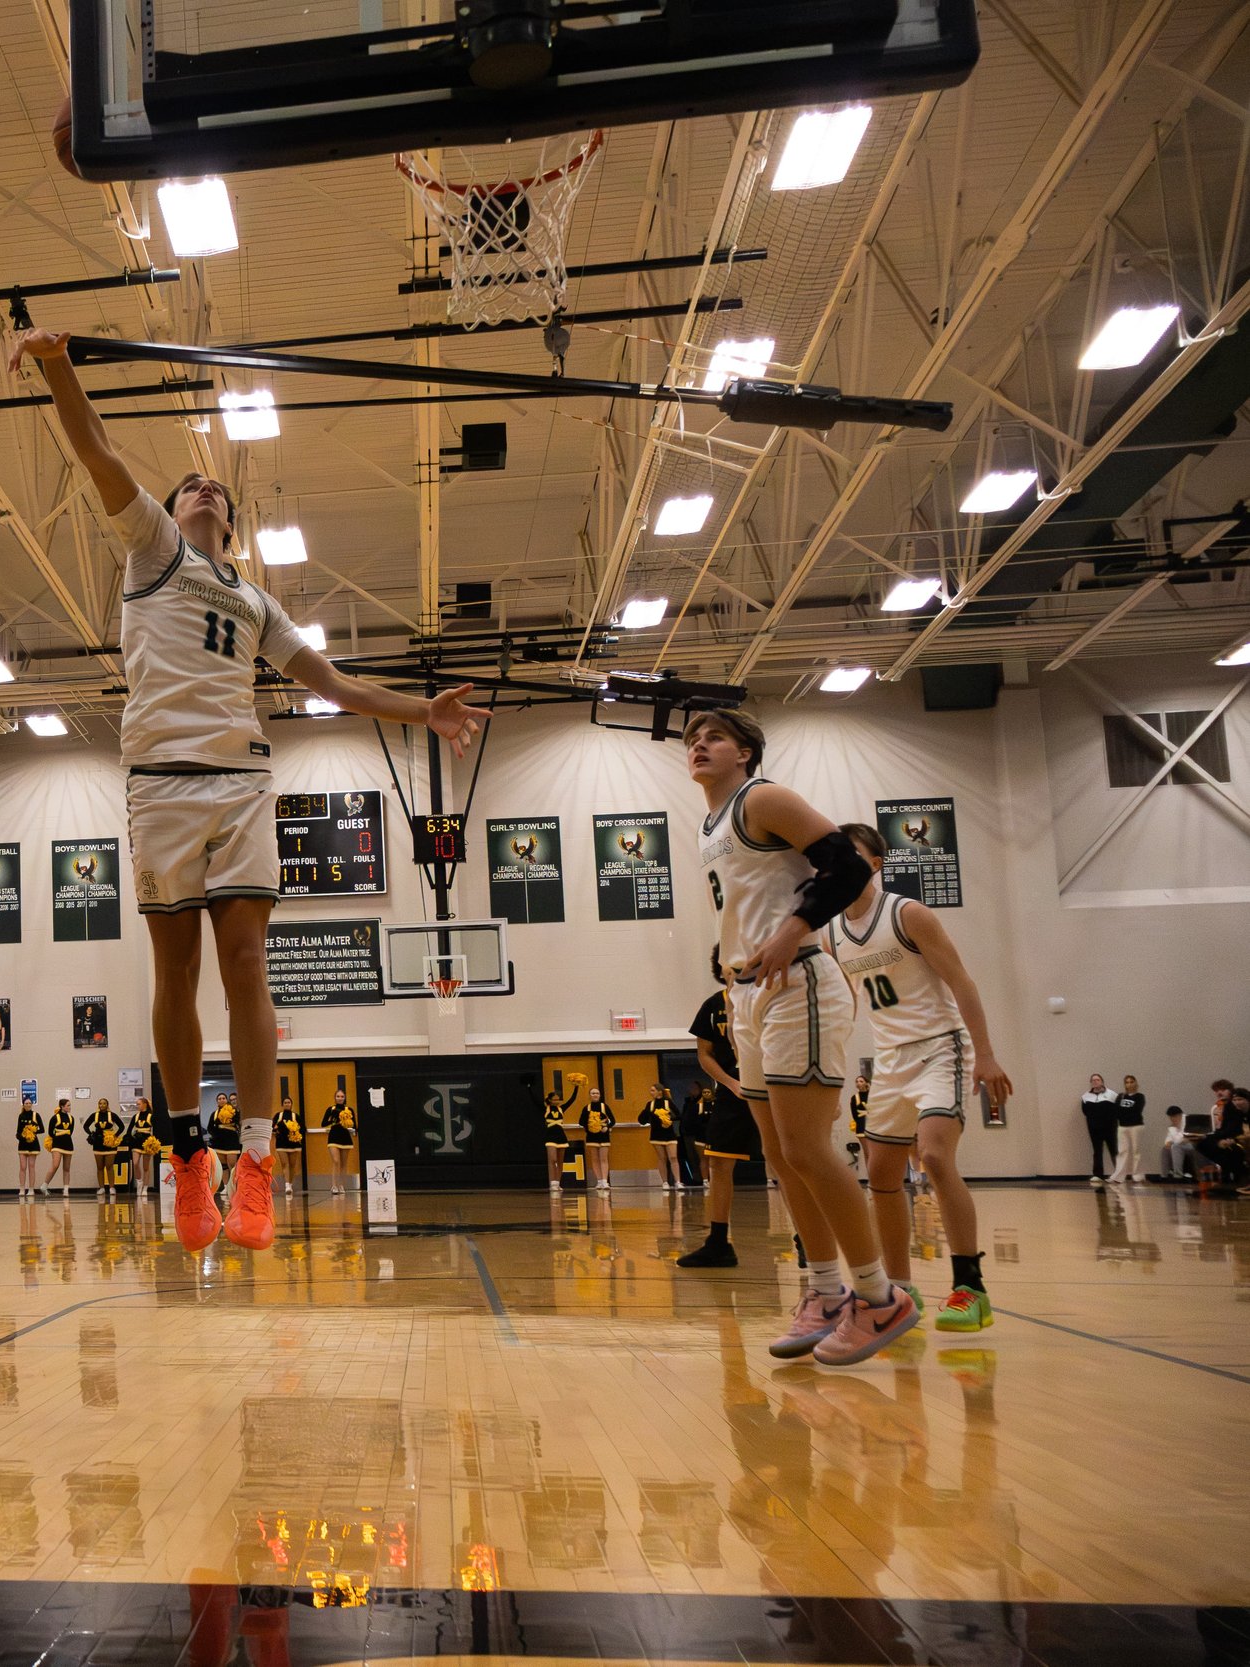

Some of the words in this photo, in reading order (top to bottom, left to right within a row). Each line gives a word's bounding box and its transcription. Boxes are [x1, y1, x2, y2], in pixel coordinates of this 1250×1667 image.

[204, 610, 235, 657] 11
[279, 796, 324, 816] 6:34
[337, 819, 370, 829] GUEST
[427, 819, 459, 833] 6:34
[298, 838, 301, 851] 1
[359, 832, 371, 852] 0
[436, 834, 454, 858] 10
[332, 865, 341, 881] 5
[369, 865, 372, 878] 1
[285, 886, 309, 894] MATCH
[265, 938, 274, 947] EE
[276, 937, 299, 947] STATE
[301, 936, 322, 946] ALMA
[324, 935, 350, 945] MATER
[271, 963, 280, 971] AND
[281, 962, 291, 970] WITH
[292, 962, 307, 970] HONOR
[326, 961, 335, 969] OUR
[269, 985, 284, 993] RENCE
[863, 973, 899, 1011] 10
